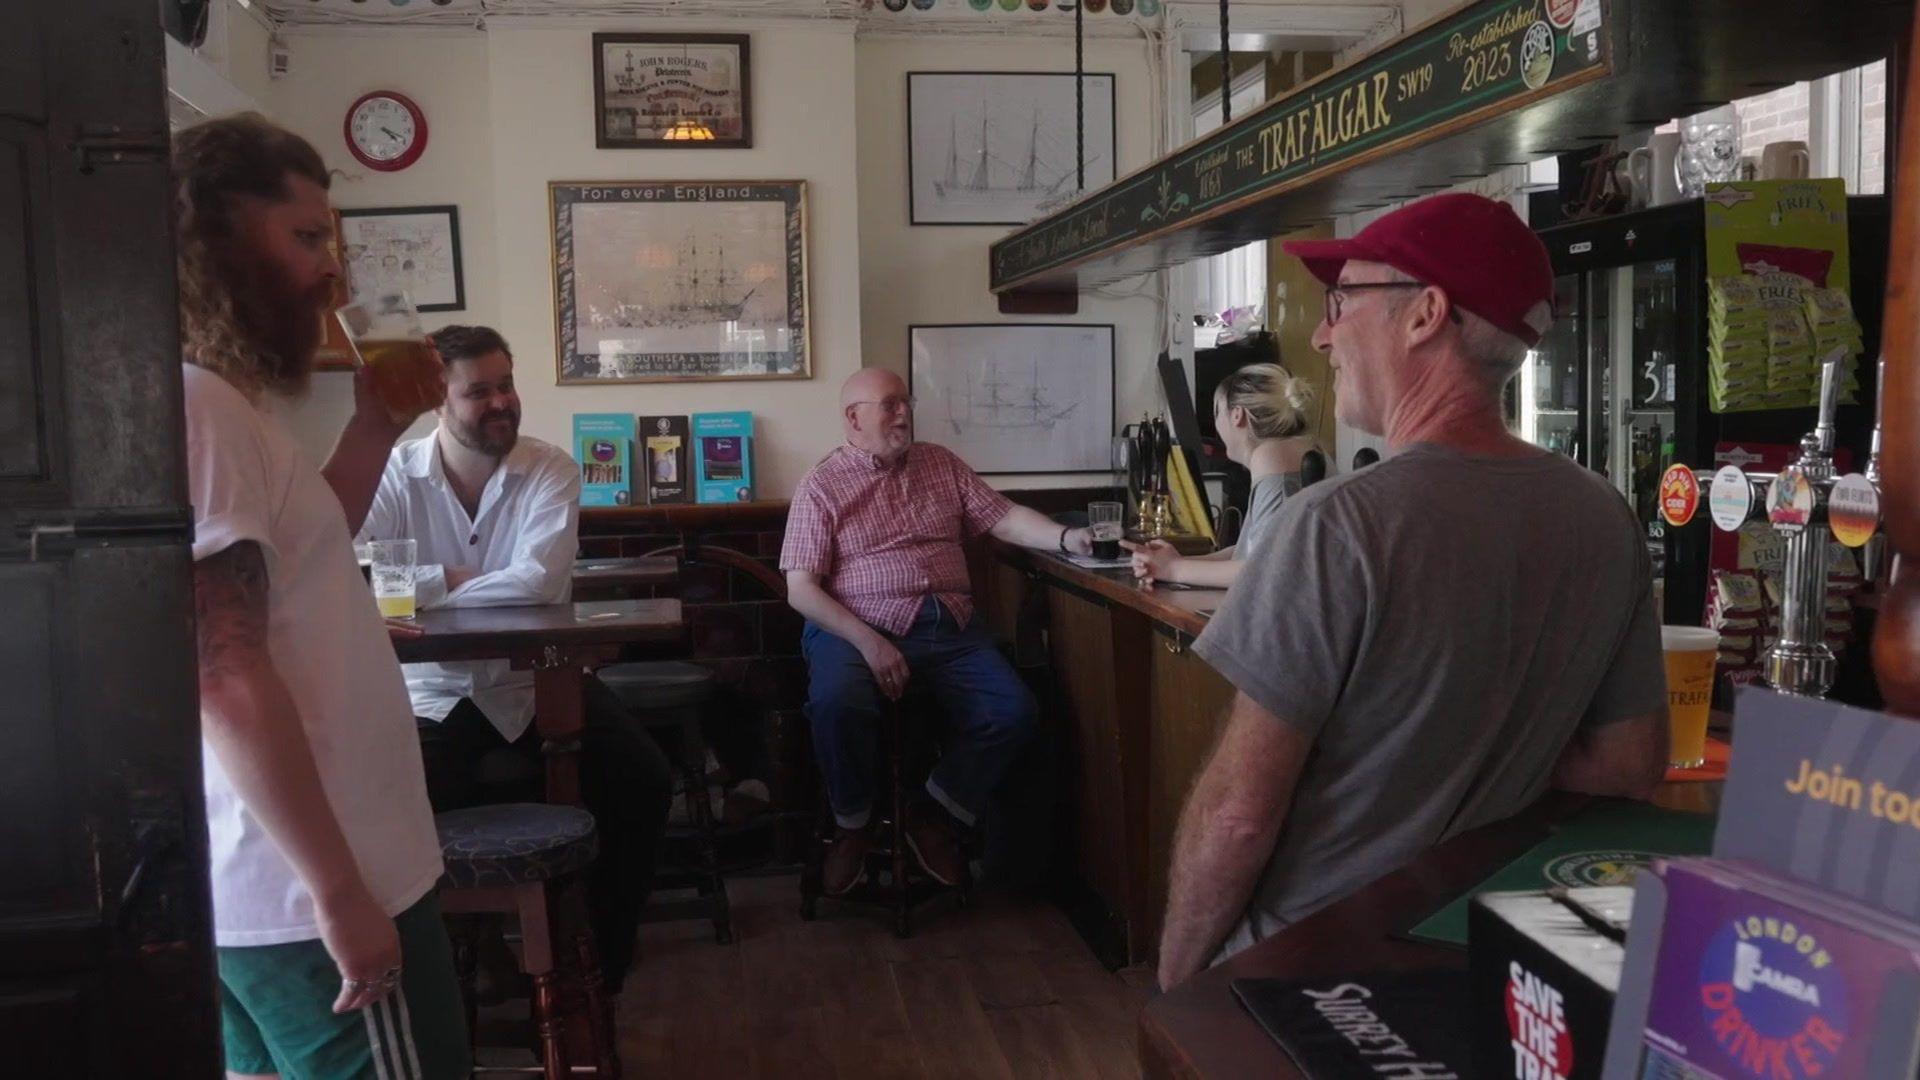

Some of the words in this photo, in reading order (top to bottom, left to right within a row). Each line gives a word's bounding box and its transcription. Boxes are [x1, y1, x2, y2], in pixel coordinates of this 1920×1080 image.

[1461, 41, 1512, 93] 2023
[1236, 145, 1255, 171] THE
[1258, 70, 1392, 175] TRAFALGAR
[1397, 64, 1434, 101] SW19
[581, 187, 612, 199] For
[621, 188, 666, 199] ever
[1752, 547, 1782, 564] FRI
[1785, 760, 1861, 810] Join
[1734, 915, 1832, 969] LONDON
[1302, 983, 1417, 1058] SURREY
[1509, 961, 1565, 1033] SAVE
[1512, 1002, 1558, 1068] THE
[1701, 982, 1845, 1080] DRINKER
